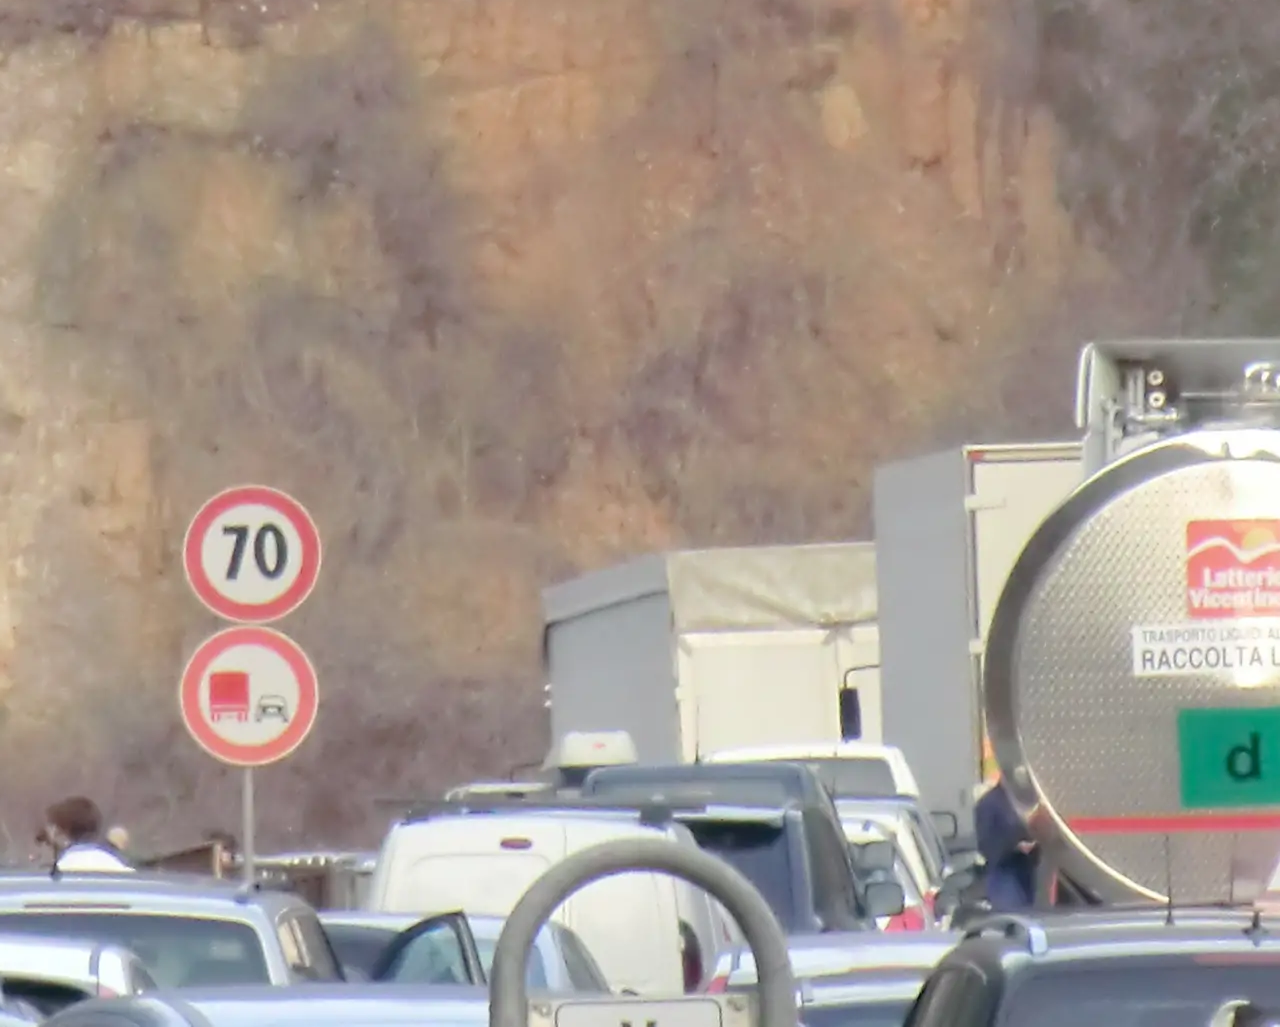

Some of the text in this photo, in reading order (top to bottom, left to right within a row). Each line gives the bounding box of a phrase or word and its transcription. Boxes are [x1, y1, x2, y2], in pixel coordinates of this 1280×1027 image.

[222, 523, 288, 581] 70
[1142, 629, 1217, 643] TRASPORTO
[1220, 628, 1264, 641] LIQUID
[1142, 646, 1263, 670] RACCOLTA
[1225, 732, 1262, 782] d
